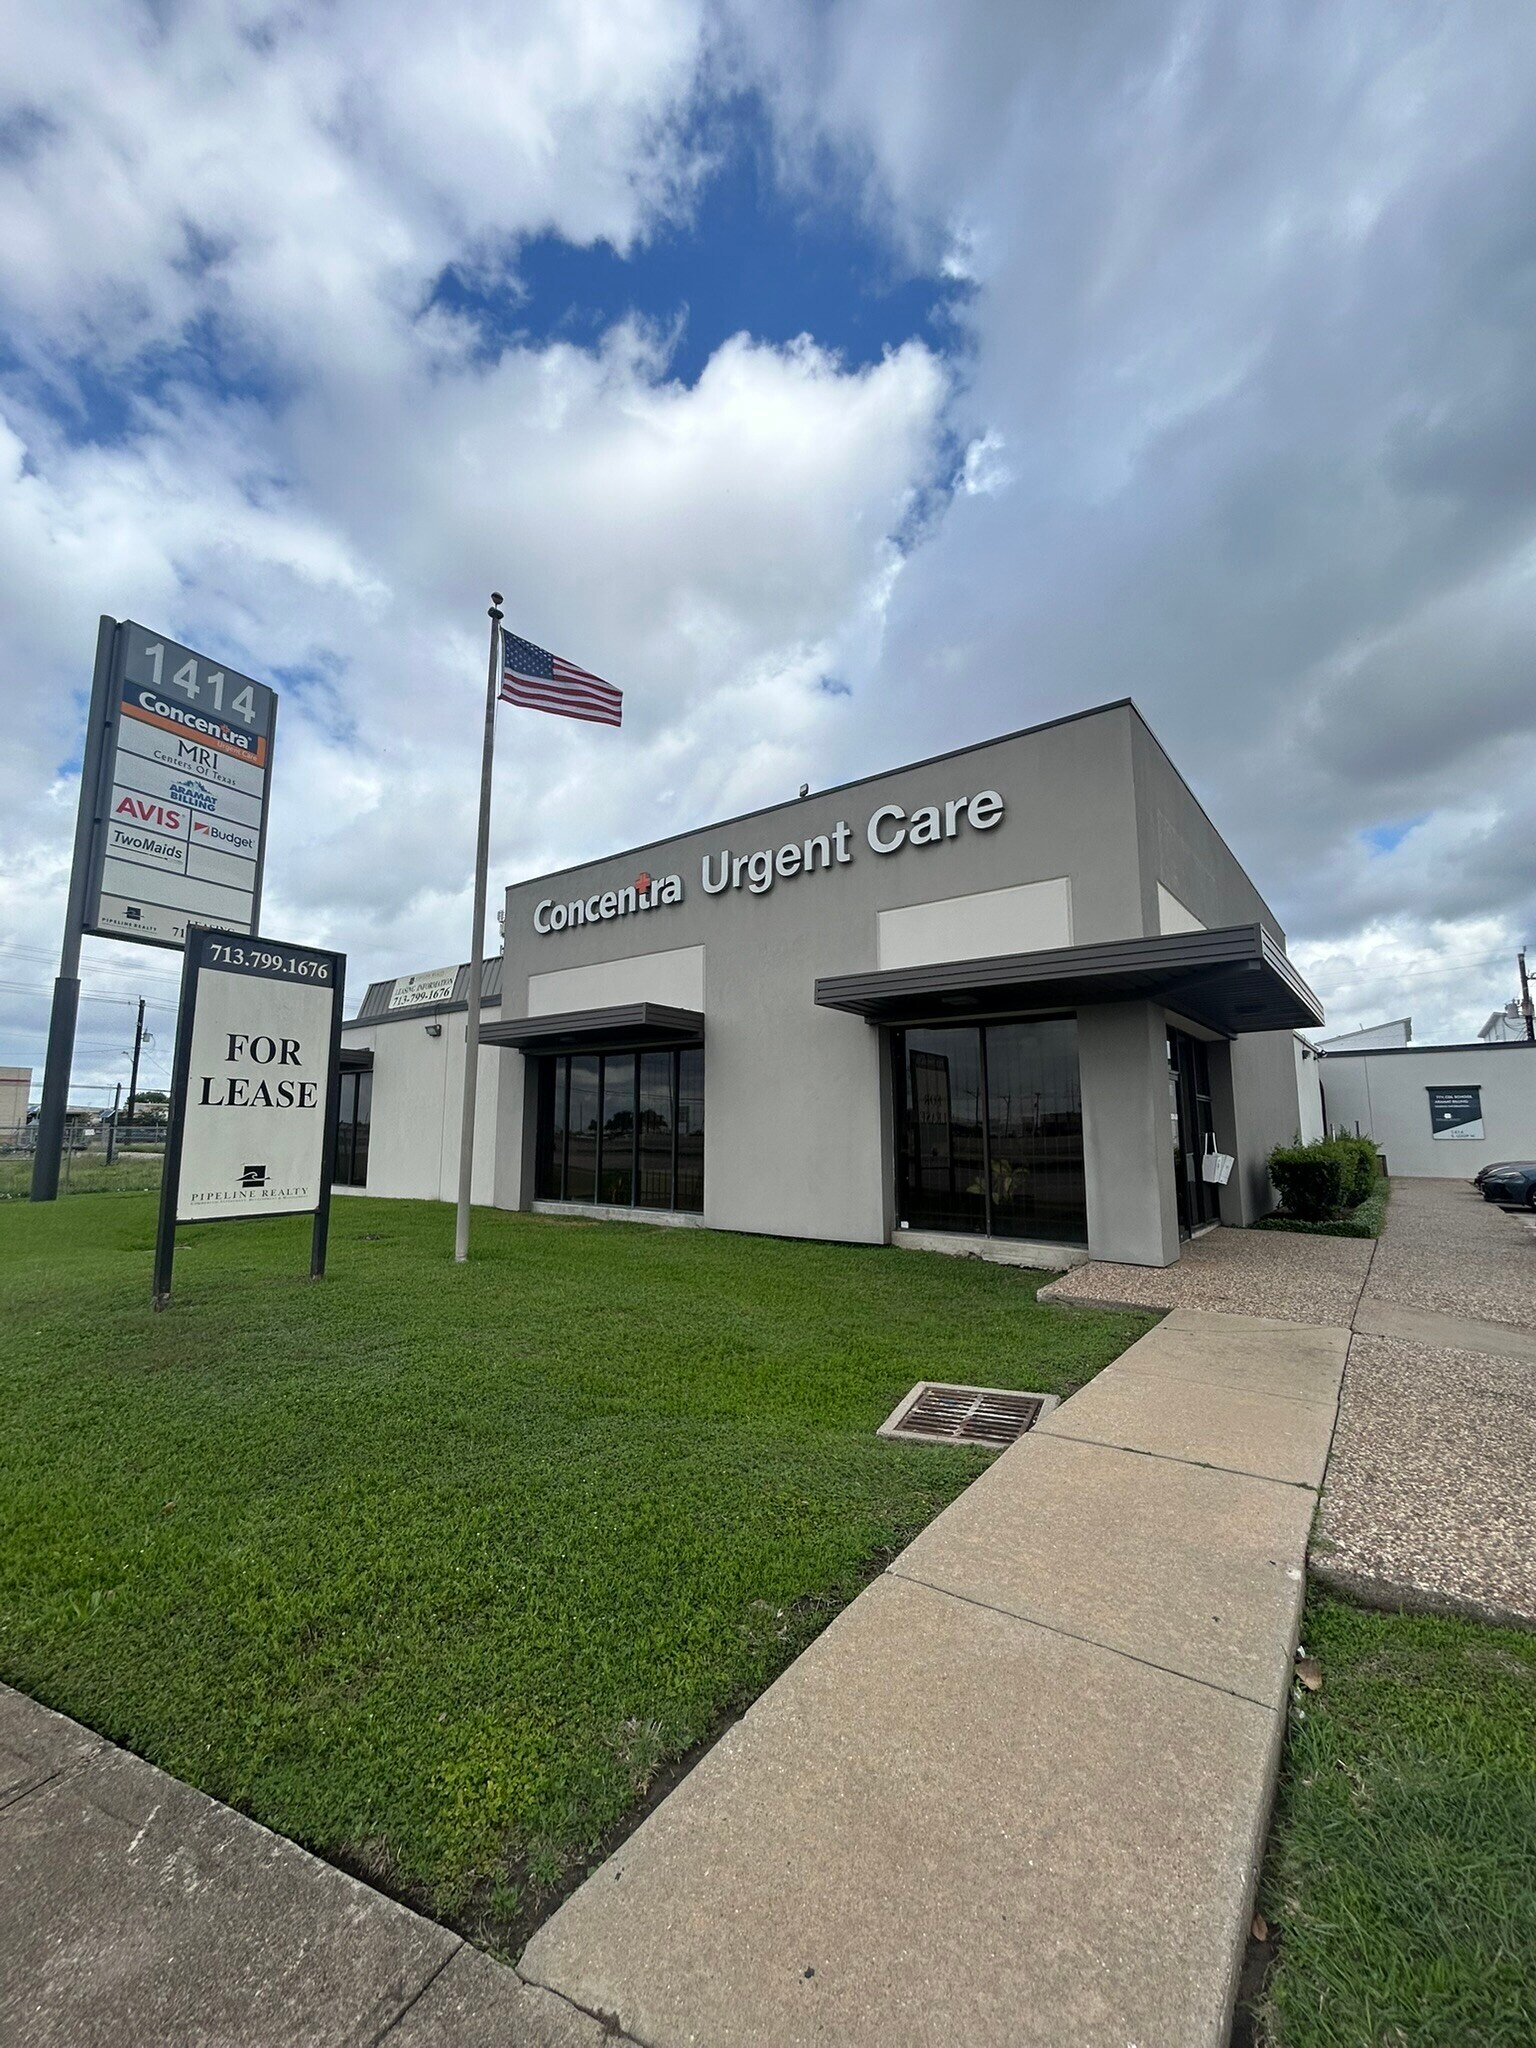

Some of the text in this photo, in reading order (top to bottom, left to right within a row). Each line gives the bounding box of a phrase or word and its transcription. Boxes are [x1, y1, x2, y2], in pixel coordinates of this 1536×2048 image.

[145, 642, 256, 724] 1414
[138, 691, 249, 749] Concentra
[177, 740, 218, 770] MRI
[217, 741, 258, 761] Urgent Care
[153, 750, 236, 786] Centers Of Texas
[169, 784, 217, 804] ARAMAT
[171, 792, 216, 811] BILLING
[115, 797, 181, 829] AVIS
[114, 830, 182, 859] TwoMaids
[210, 827, 253, 848] Budget
[533, 790, 1005, 934] Concentra Urgent Care
[102, 917, 157, 931] PIPELINE REALTY
[210, 943, 329, 979] 713.799.1676
[225, 1033, 302, 1066] FOR
[198, 1076, 318, 1109] LEASE
[192, 1189, 256, 1201] PIPELINE
[262, 1187, 309, 1197] REALTY
